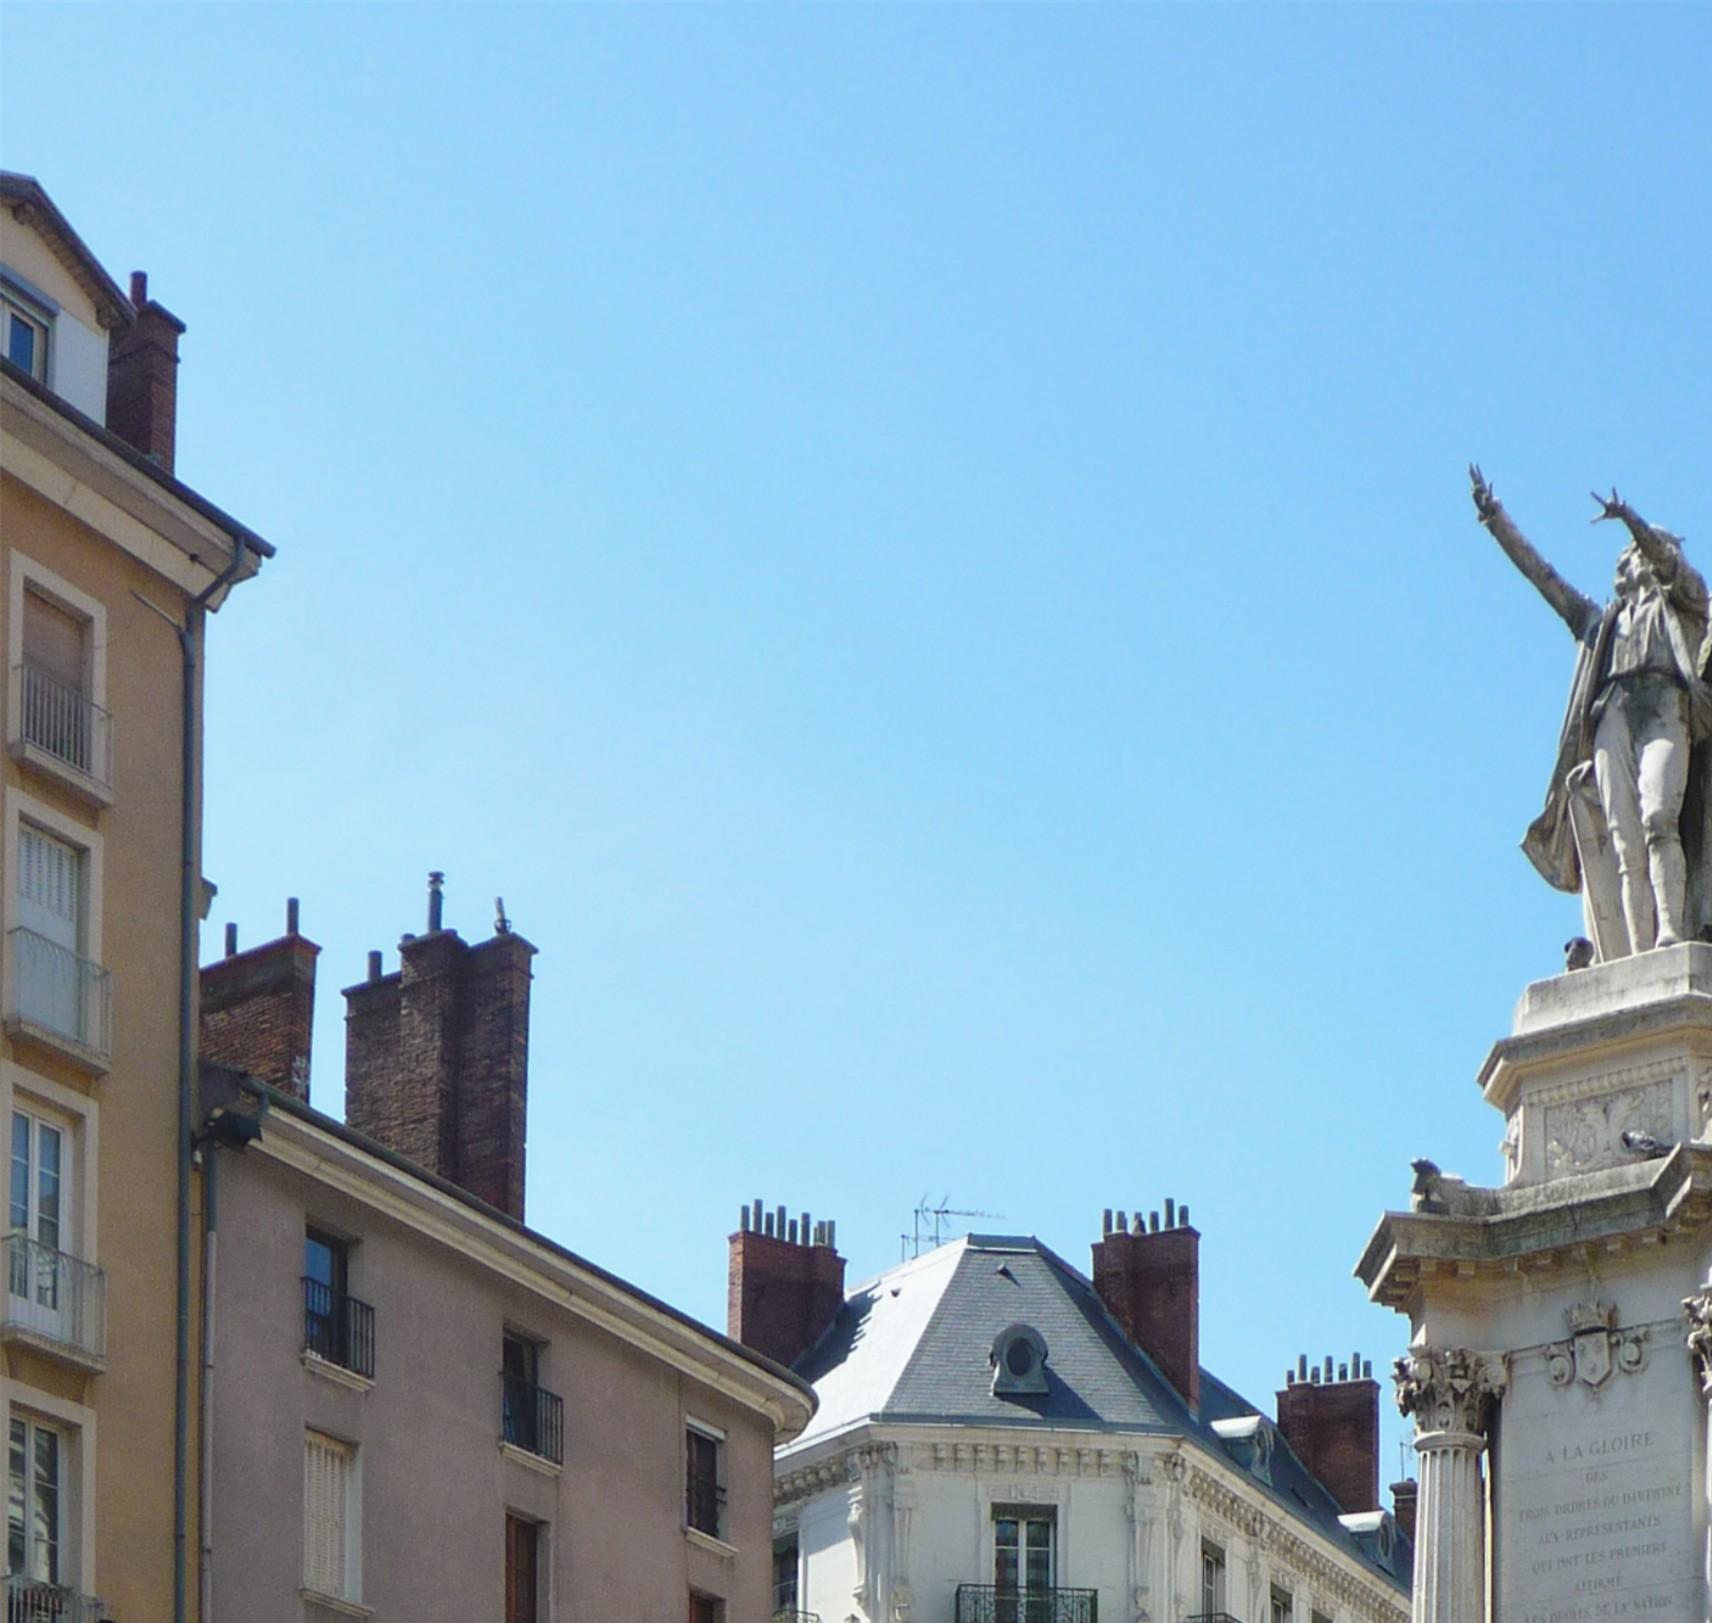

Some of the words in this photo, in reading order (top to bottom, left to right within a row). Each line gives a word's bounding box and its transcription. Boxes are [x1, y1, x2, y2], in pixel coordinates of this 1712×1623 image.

[1563, 1446, 1583, 1462] LA
[1589, 1431, 1655, 1455] GLOIRE
[1603, 1494, 1620, 1507] DU
[1585, 1550, 1605, 1564] LES
